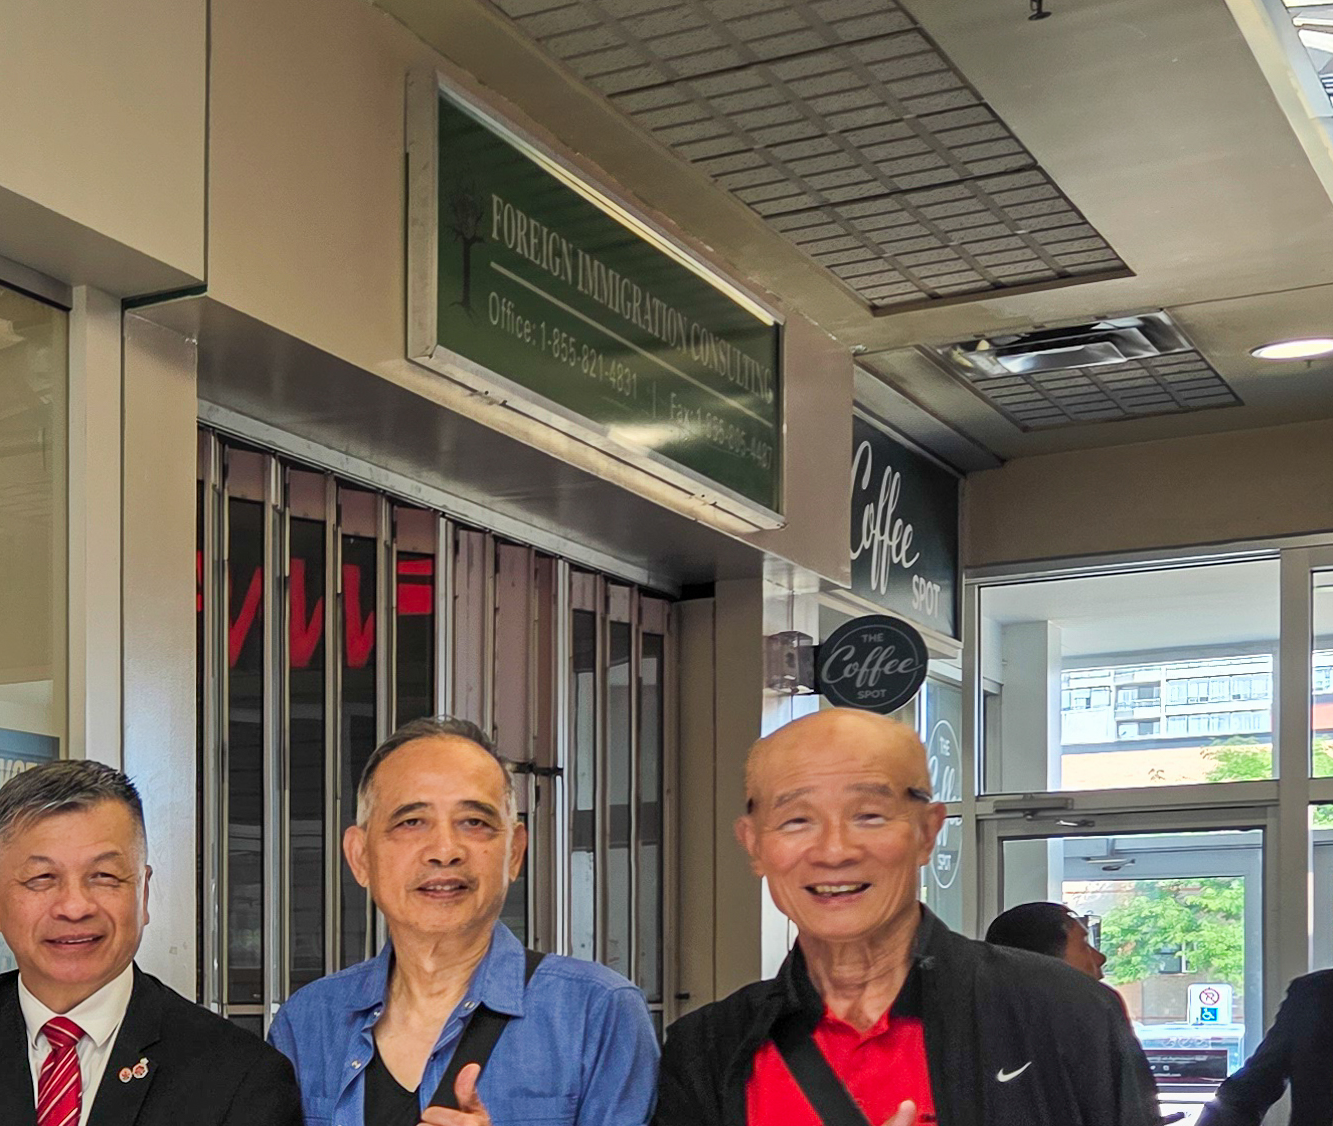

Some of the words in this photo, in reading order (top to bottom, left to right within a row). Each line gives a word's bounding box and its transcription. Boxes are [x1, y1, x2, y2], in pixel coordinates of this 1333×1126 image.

[492, 194, 573, 285] FOREIGN
[577, 249, 688, 354] IMMIGRATION
[489, 291, 536, 346] Office:
[850, 440, 920, 595] Coffee
[911, 574, 941, 618] SPOT
[861, 632, 885, 643] THE
[821, 644, 924, 688] Coffee
[857, 689, 887, 699] SPOT
